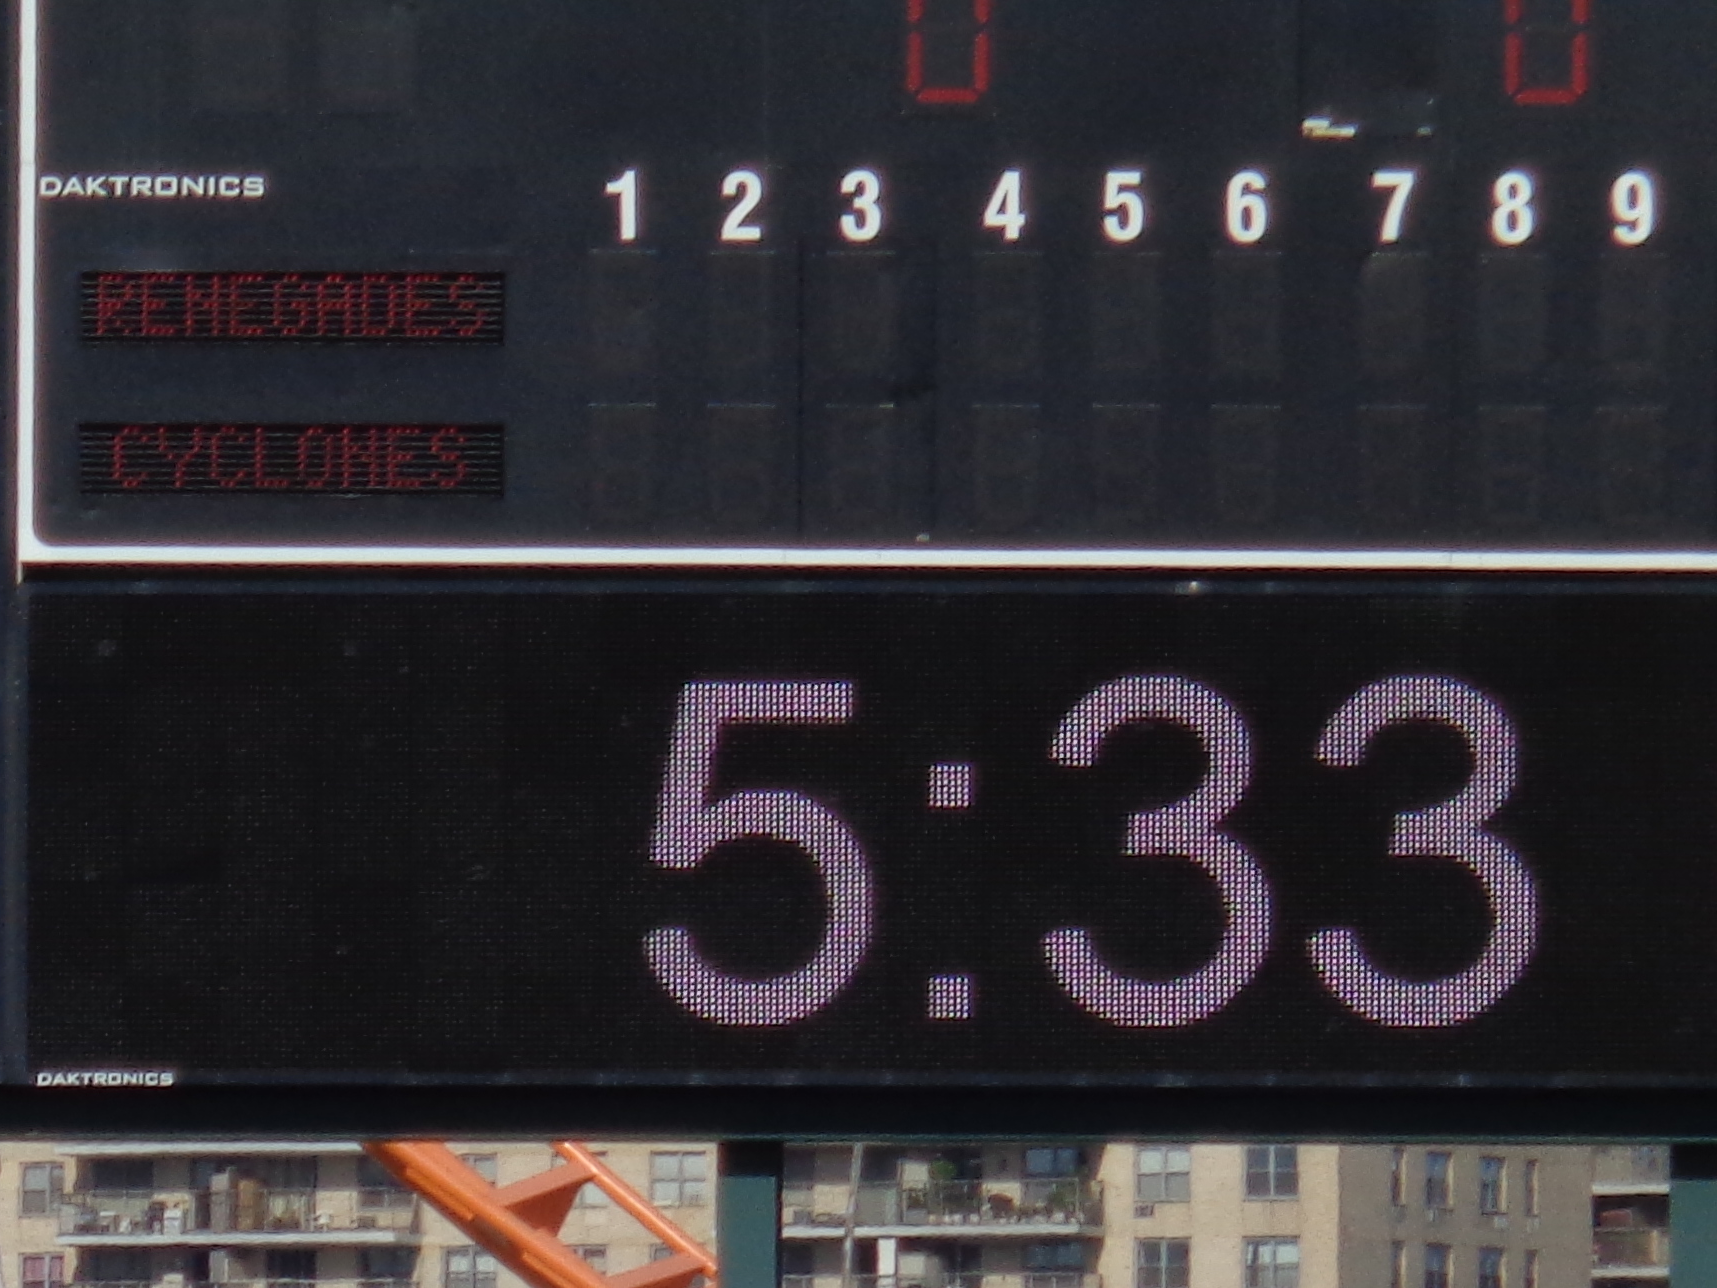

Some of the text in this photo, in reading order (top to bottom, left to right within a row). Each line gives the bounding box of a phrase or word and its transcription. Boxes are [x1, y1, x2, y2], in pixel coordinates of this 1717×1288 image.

[39, 175, 266, 198] DAKTRONICS
[606, 168, 1655, 244] 1 2 3 4 5 6 7 8 9
[95, 273, 488, 337] RENEGADES
[111, 426, 467, 490] CYCLONES
[642, 674, 1539, 1030] 5:33
[36, 1071, 175, 1087] DAKTRONICS
